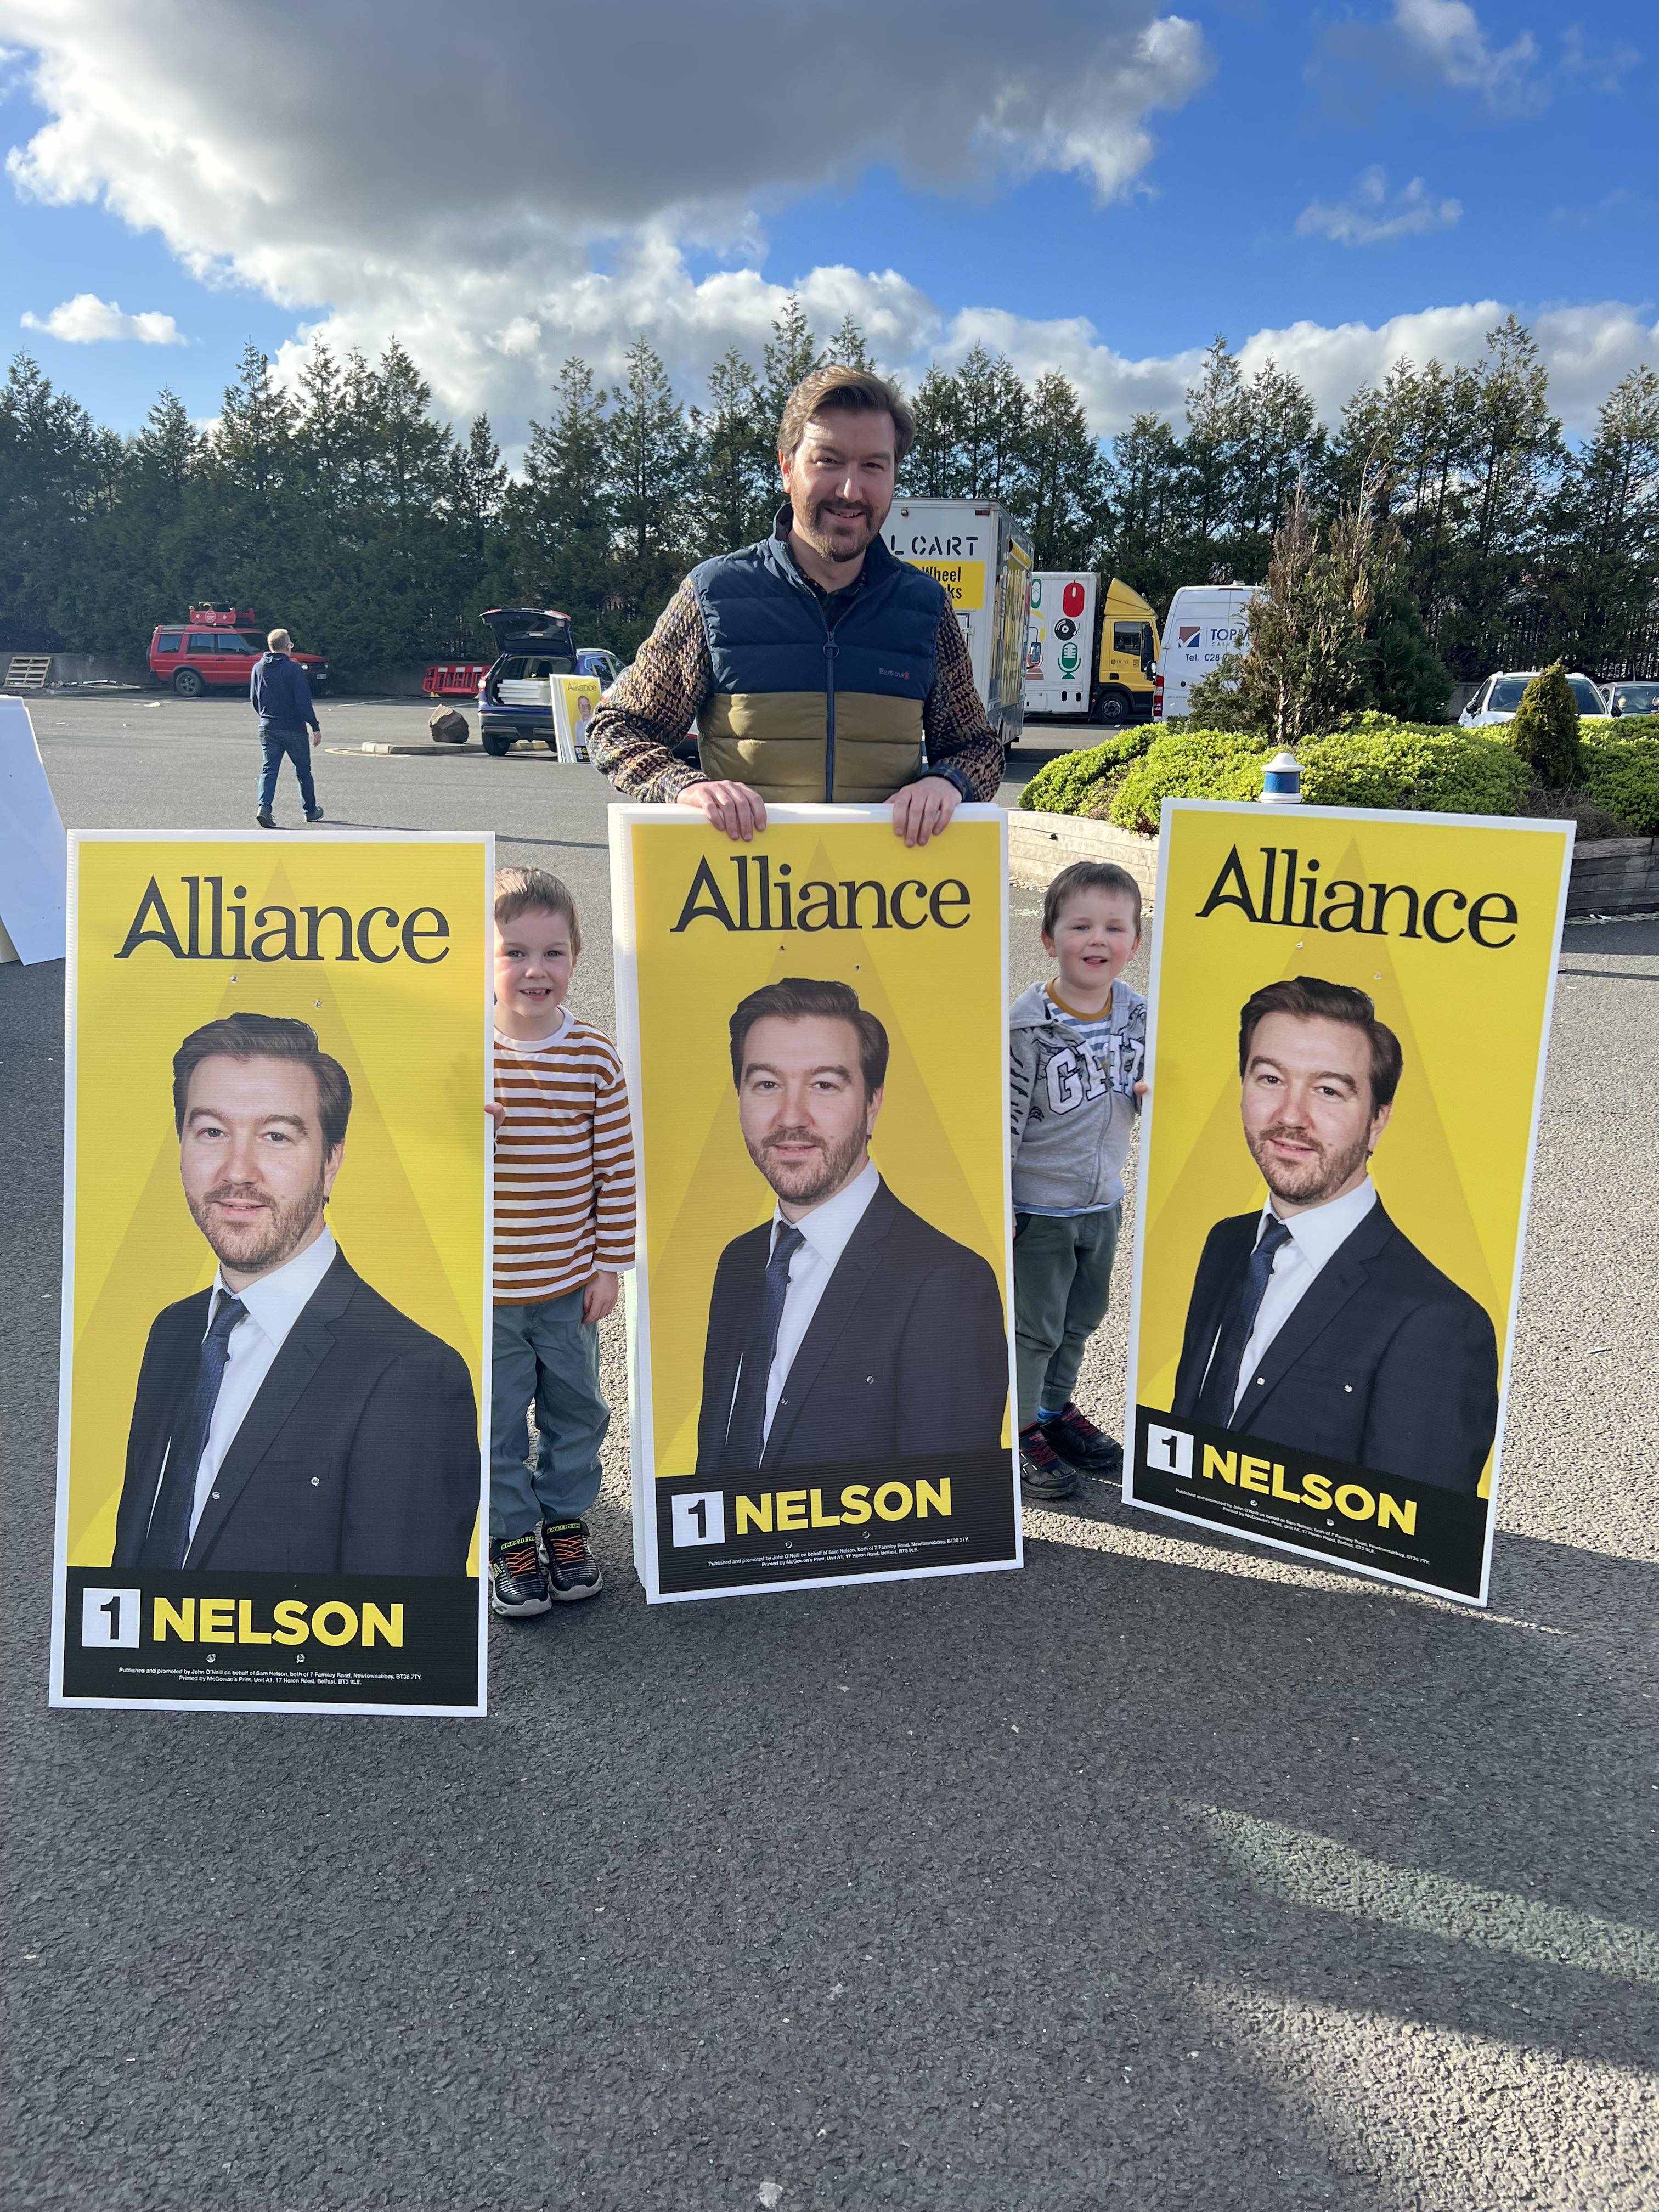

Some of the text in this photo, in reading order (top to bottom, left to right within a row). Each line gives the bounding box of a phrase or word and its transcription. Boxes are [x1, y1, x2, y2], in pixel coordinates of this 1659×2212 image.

[912, 536, 978, 555] CART
[879, 667, 905, 678] Barbour
[1186, 653, 1199, 662] Tel.
[567, 682, 597, 691] Alliance
[670, 855, 970, 933] Alliance
[1195, 844, 1517, 949] Alliance
[114, 875, 450, 964] Alliance
[687, 1479, 951, 1538] 1 NELSON
[1162, 1436, 1416, 1534] 1 NELSON
[547, 1523, 581, 1533] SKECHERS
[101, 1597, 403, 1646] 1 NELSON
